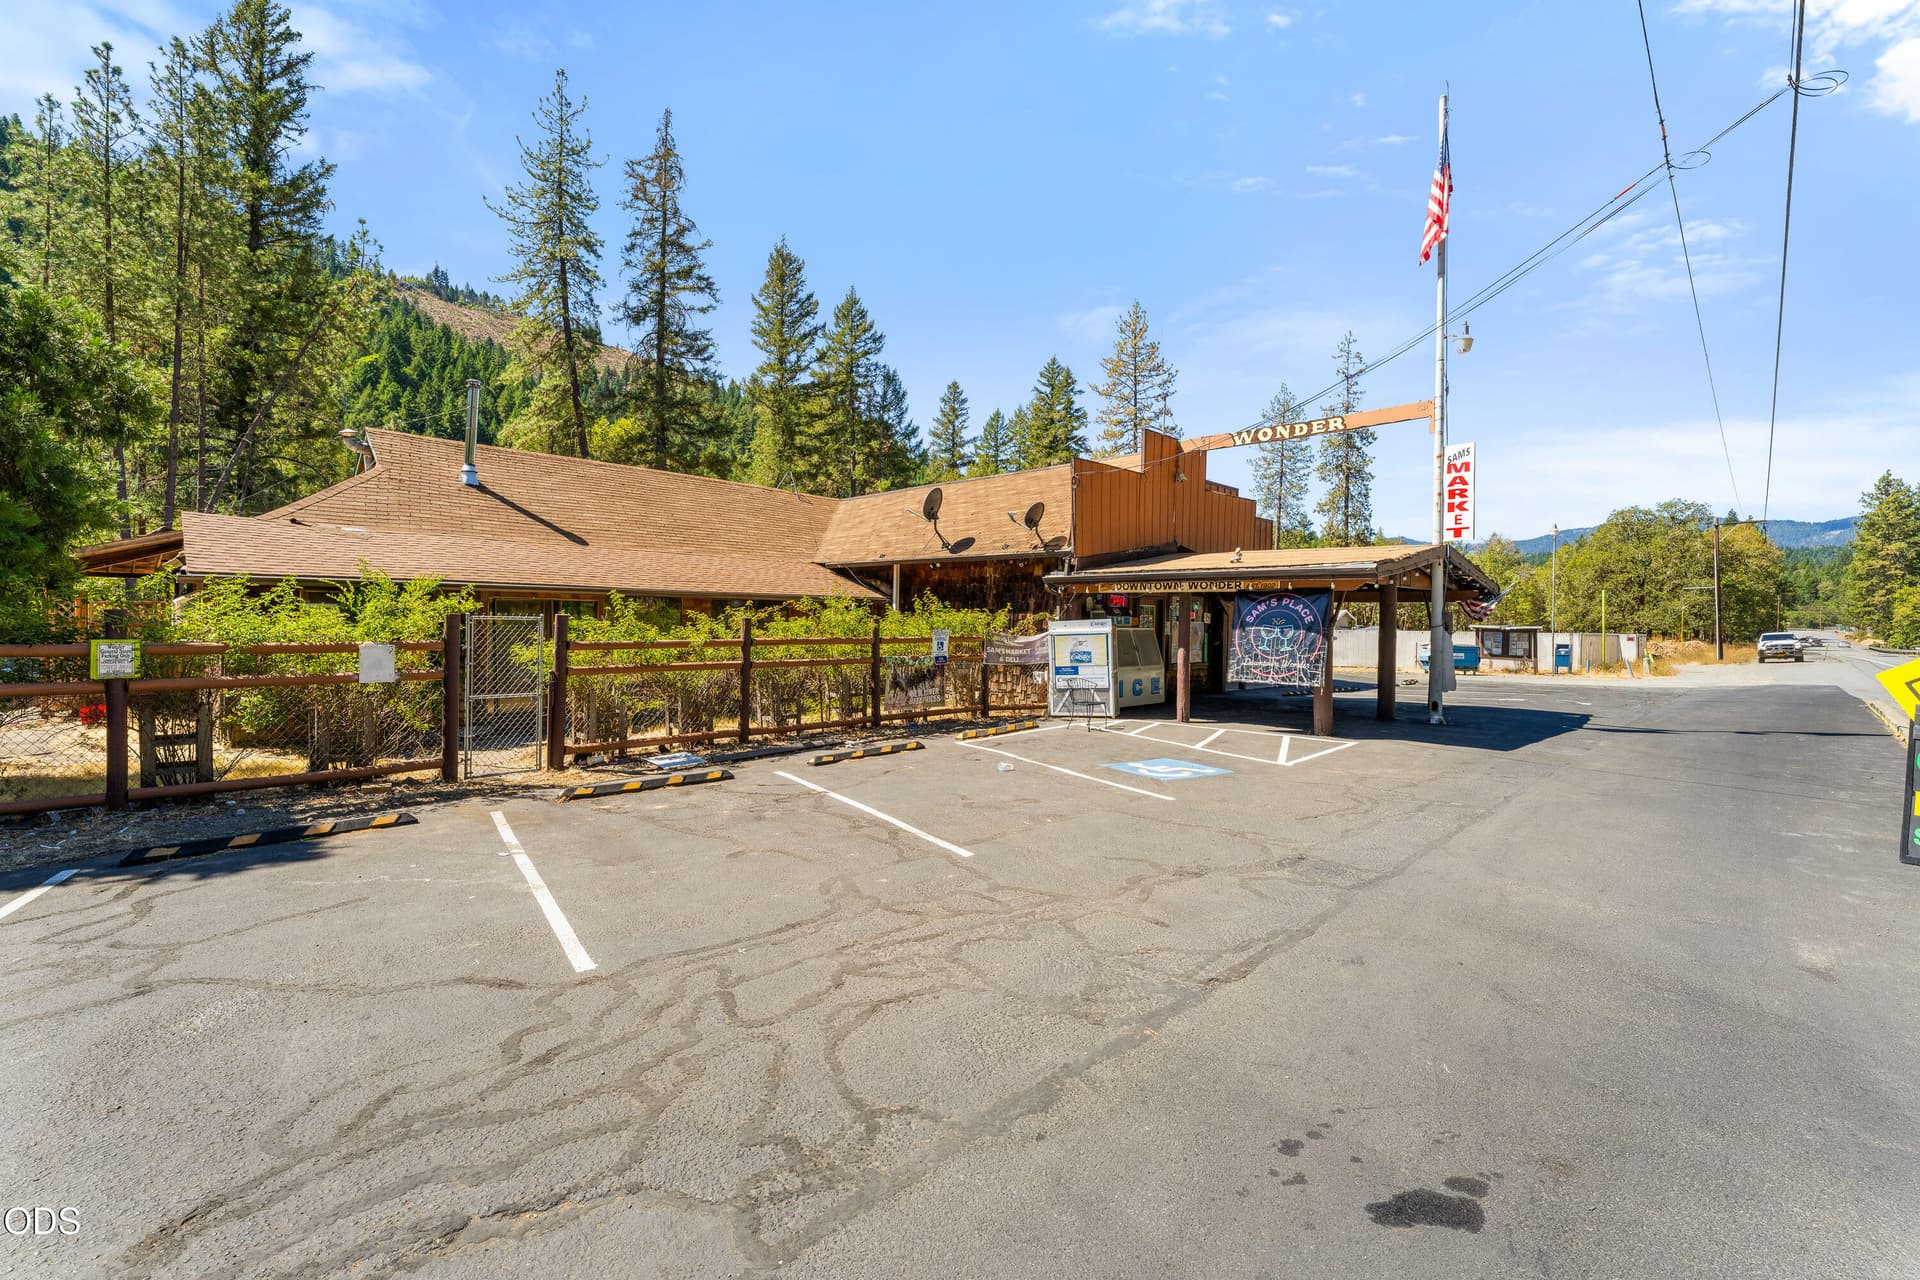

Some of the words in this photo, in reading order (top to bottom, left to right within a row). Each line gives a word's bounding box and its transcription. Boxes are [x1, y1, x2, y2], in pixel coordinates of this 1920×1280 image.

[1232, 417, 1345, 446] WONDER
[1446, 461, 1471, 538] MARKET
[1116, 582, 1181, 591] DOWNTOWN
[1188, 580, 1242, 590] WONDER
[1246, 598, 1278, 623] SAM'S
[1282, 598, 1314, 624] PLACE
[1118, 677, 1162, 698] ICE
